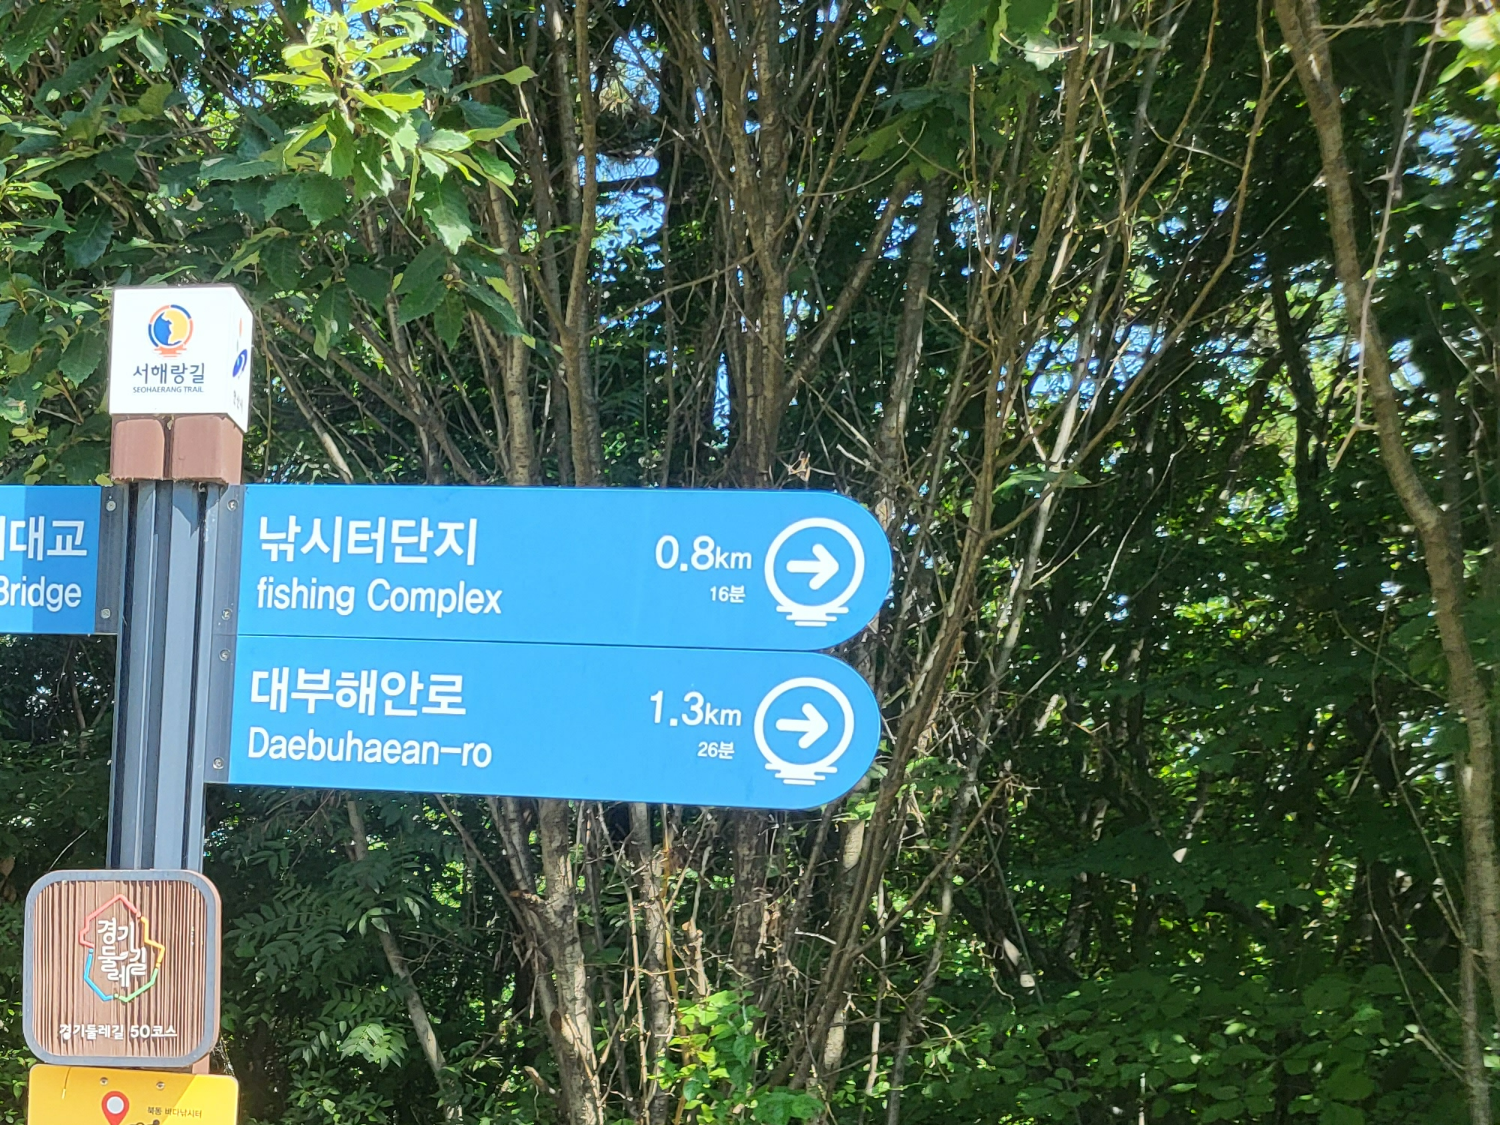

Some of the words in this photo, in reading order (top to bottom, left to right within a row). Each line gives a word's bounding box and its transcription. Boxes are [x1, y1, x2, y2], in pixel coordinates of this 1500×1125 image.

[133, 362, 205, 384] 서해랑길
[259, 515, 478, 566] 낚시터단지
[655, 534, 752, 574] 0.8km
[256, 578, 355, 616] fishing
[367, 579, 503, 619] Complex
[710, 584, 746, 604] 16분
[250, 668, 467, 718] 대부해안로
[650, 690, 742, 728] 1.3km
[248, 727, 493, 768] Daebuhaean-ro
[697, 740, 735, 761] 26분
[97, 918, 134, 953] 경기
[59, 1024, 124, 1041] 경기둘레길
[130, 1024, 178, 1039] 50코스
